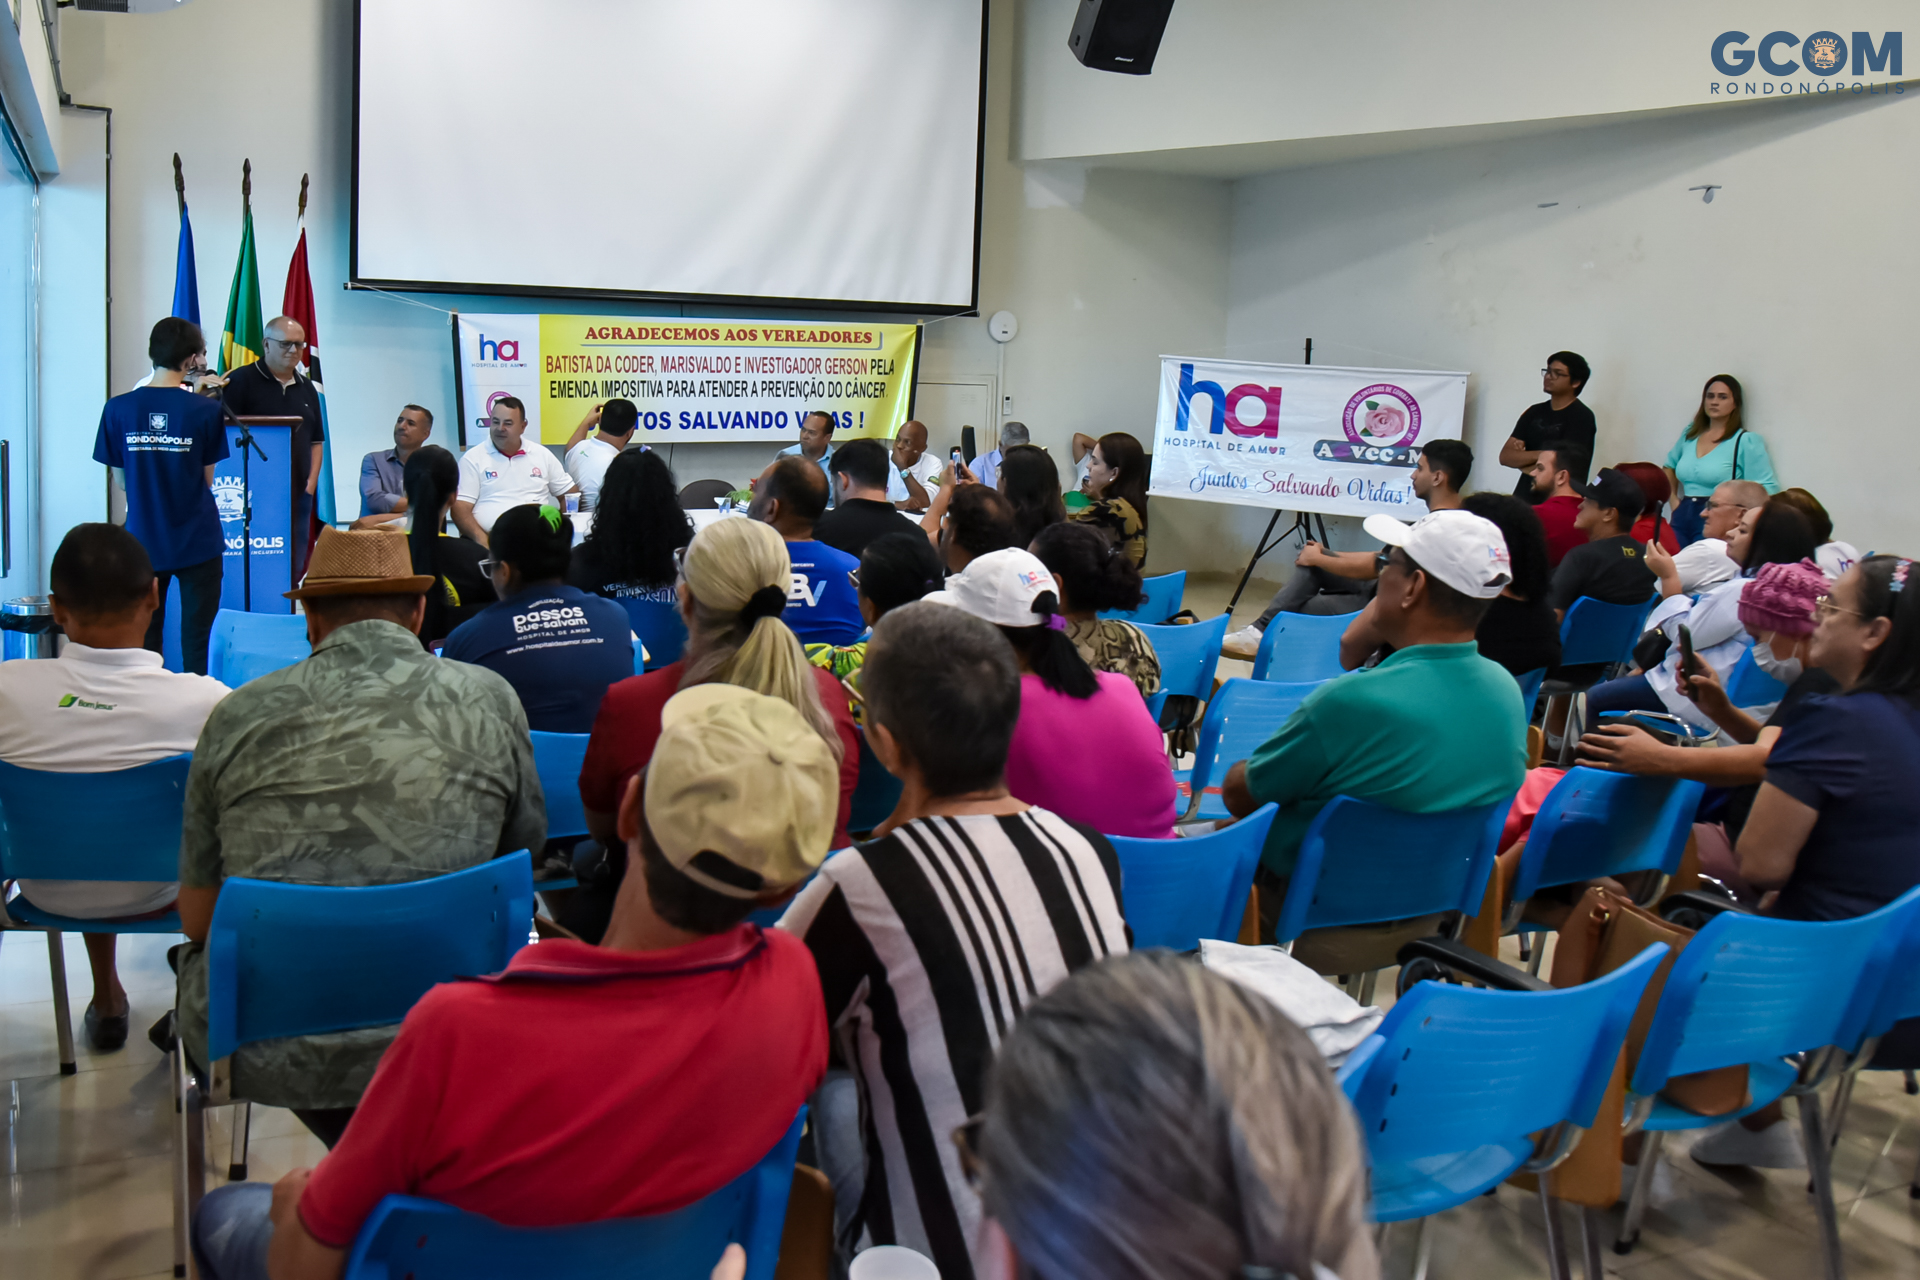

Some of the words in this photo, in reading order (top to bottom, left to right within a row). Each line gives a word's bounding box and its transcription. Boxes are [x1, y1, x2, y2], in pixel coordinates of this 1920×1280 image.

[585, 326, 720, 341] AGRADECEMOS
[724, 328, 758, 342] AOS
[762, 329, 873, 344] VEREADORES
[479, 333, 519, 361] ha
[546, 355, 594, 374] BATISTA
[596, 355, 612, 374] DA
[615, 355, 658, 377] CODER,
[661, 355, 732, 374] MARISVALDO
[734, 356, 741, 374] E
[744, 356, 822, 375] INVESTIGADOR
[824, 357, 868, 376] GERSON
[870, 358, 895, 376] PELA
[550, 380, 599, 398] EMENDA
[601, 379, 664, 398] IMPOSITIVA
[666, 379, 696, 398] PARA
[698, 379, 749, 398] ATENDER
[750, 380, 759, 398] A
[761, 377, 825, 402] PREVENÇÃO
[827, 380, 843, 398] DO
[1174, 363, 1282, 439] ha
[679, 411, 789, 430] SALVANDO
[795, 410, 853, 429] VAS
[859, 411, 865, 429] !
[126, 434, 193, 445] RONDONÓPOLIS
[1164, 436, 1222, 450] HOSPITAL
[1227, 442, 1243, 452] DE
[1189, 465, 1249, 493] Juntos
[1254, 470, 1342, 498] Salvando
[1347, 478, 1411, 505] Vidas!
[517, 631, 555, 641] HOSPITAL
